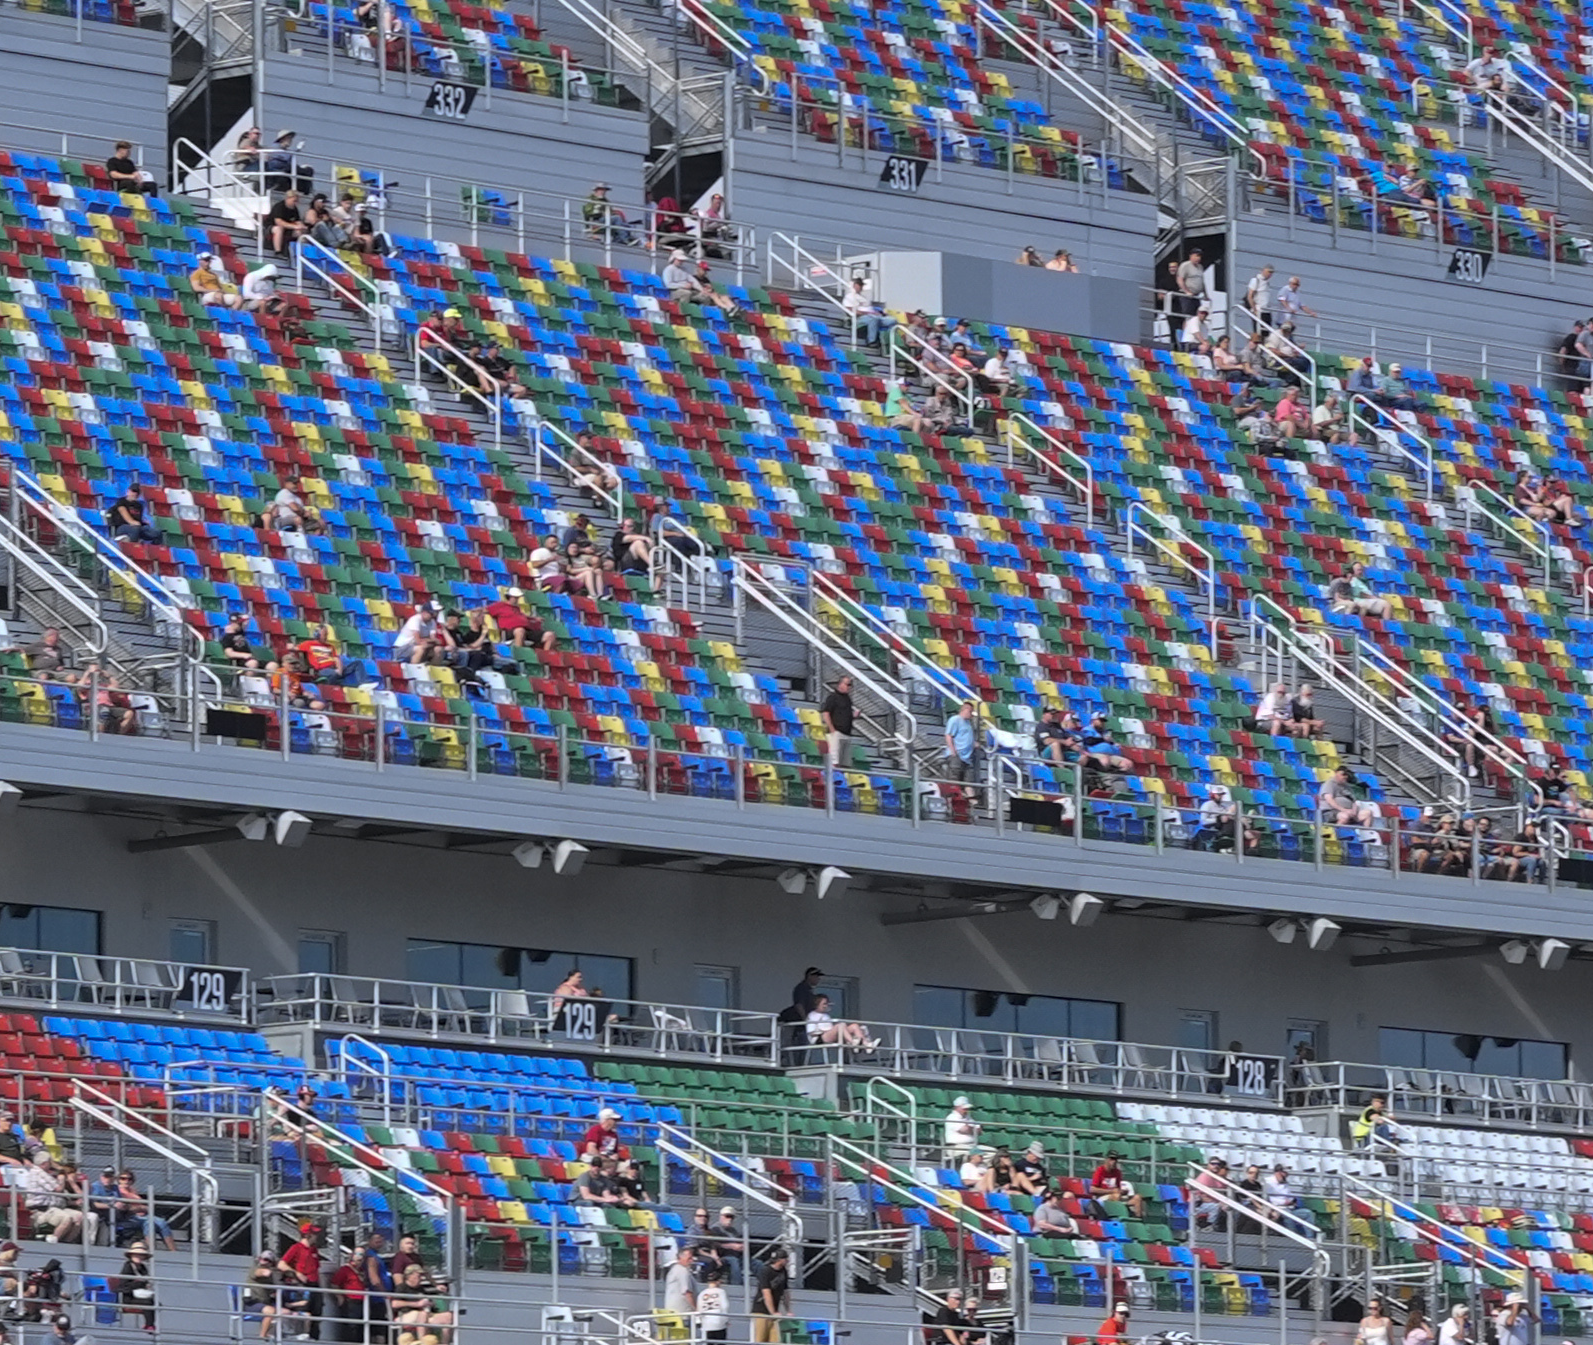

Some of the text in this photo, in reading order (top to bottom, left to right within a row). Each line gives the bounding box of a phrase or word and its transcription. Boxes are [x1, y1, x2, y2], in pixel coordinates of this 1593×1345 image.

[433, 84, 466, 119] 332
[889, 158, 916, 192] 331
[1456, 250, 1483, 283] 330
[190, 972, 225, 1010] 129
[563, 1003, 595, 1040] 129
[1236, 1060, 1265, 1094] 128
